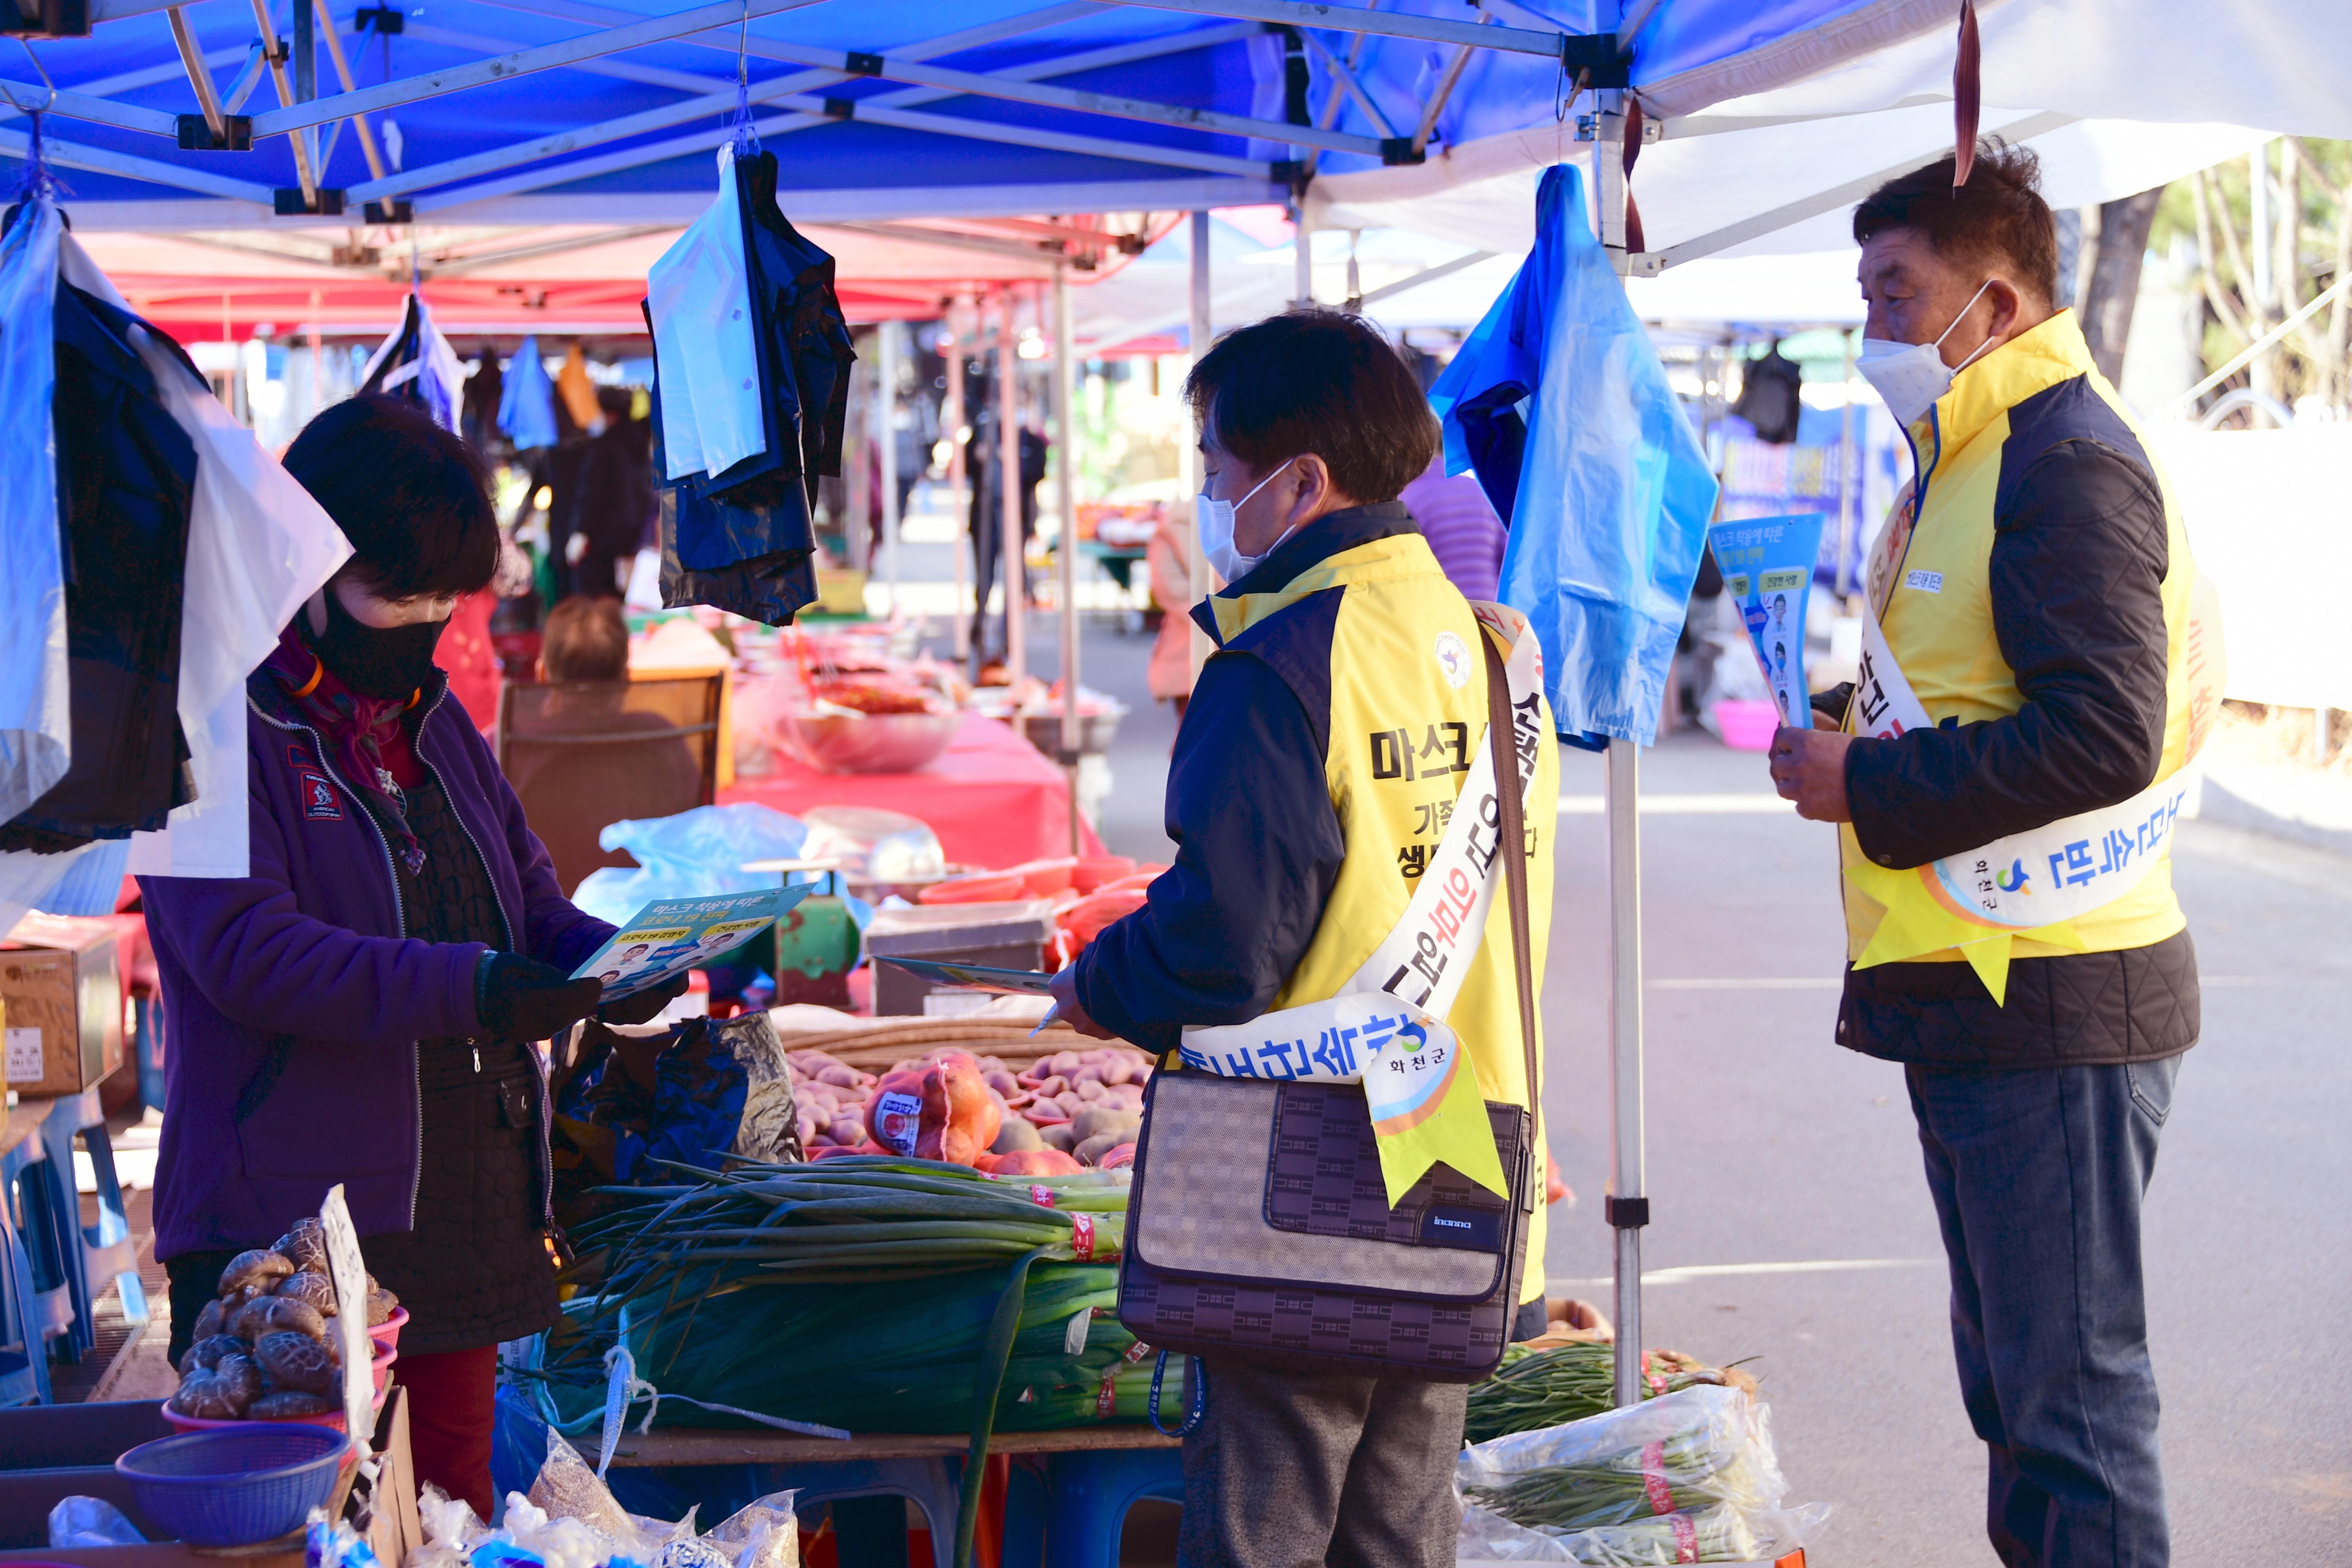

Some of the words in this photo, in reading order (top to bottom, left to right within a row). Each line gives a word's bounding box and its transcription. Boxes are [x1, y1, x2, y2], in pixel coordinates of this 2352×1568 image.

[1784, 574, 1797, 585] 사람
[1370, 722, 1471, 782] 마스크
[653, 904, 693, 914] 마스크
[696, 899, 737, 912] 착용에
[736, 896, 765, 907] 따른
[640, 915, 682, 926] 코로나
[682, 914, 700, 923] 19
[700, 910, 729, 921] 전파
[659, 931, 686, 939] 감염자
[716, 924, 743, 932] 건강한
[1389, 1048, 1446, 1075] 화천군
[1434, 1216, 1472, 1229] inanna
